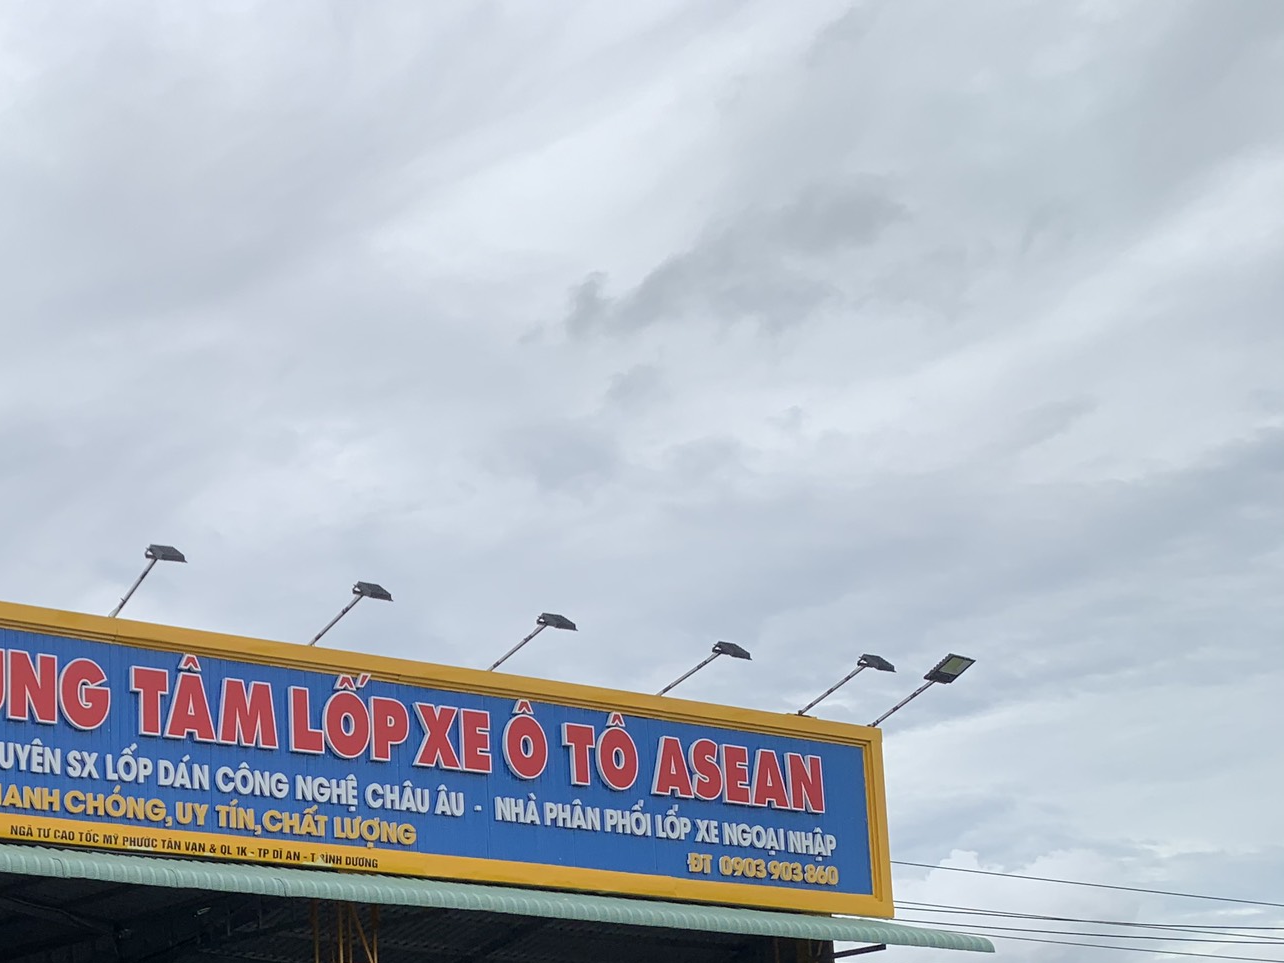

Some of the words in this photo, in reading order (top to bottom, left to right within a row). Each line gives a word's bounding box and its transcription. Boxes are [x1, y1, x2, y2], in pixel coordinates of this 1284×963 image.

[129, 653, 279, 749] TÂM
[287, 673, 410, 762] LỐP
[412, 701, 493, 774] XE
[502, 699, 548, 780] Ô
[561, 711, 639, 791] TÔ
[650, 735, 826, 814] ASEAN
[64, 785, 173, 827] CHÓNG,
[176, 802, 209, 826] UY
[215, 799, 261, 835] TÍN,
[262, 805, 328, 837] CHẤT
[334, 815, 417, 849] LƯỢNG
[67, 749, 99, 780] SX
[106, 743, 153, 784] LỐP
[157, 754, 210, 791] DÁN
[215, 761, 289, 799] CÔNG
[295, 773, 359, 811] NGHỆ
[365, 780, 430, 814] CHÂU
[434, 783, 465, 817] ÂU
[494, 793, 541, 826] NHÀ
[544, 799, 601, 832] PHÂN
[604, 799, 652, 837] PHỐI
[655, 804, 691, 840] LỐP
[694, 818, 719, 844] XE
[723, 822, 785, 855] NGOẠI
[787, 827, 837, 862] NHẬP
[10, 824, 33, 837] NGÃ
[37, 827, 52, 839] TƯ
[54, 829, 74, 841] CAO
[79, 829, 99, 843] TỐC
[103, 832, 119, 845] MỸ
[123, 835, 158, 849] PHƯỚC
[161, 838, 181, 850] TÂN
[184, 842, 206, 854] VẠN
[209, 844, 216, 853] &
[220, 844, 232, 856] QL
[236, 846, 247, 857] 1K
[257, 848, 269, 858] TP
[285, 851, 300, 861] AN
[345, 856, 378, 869] DƯƠNG
[687, 852, 713, 874] ĐT
[719, 855, 766, 878] 0903
[768, 860, 803, 883] 903
[804, 864, 839, 886] 860
